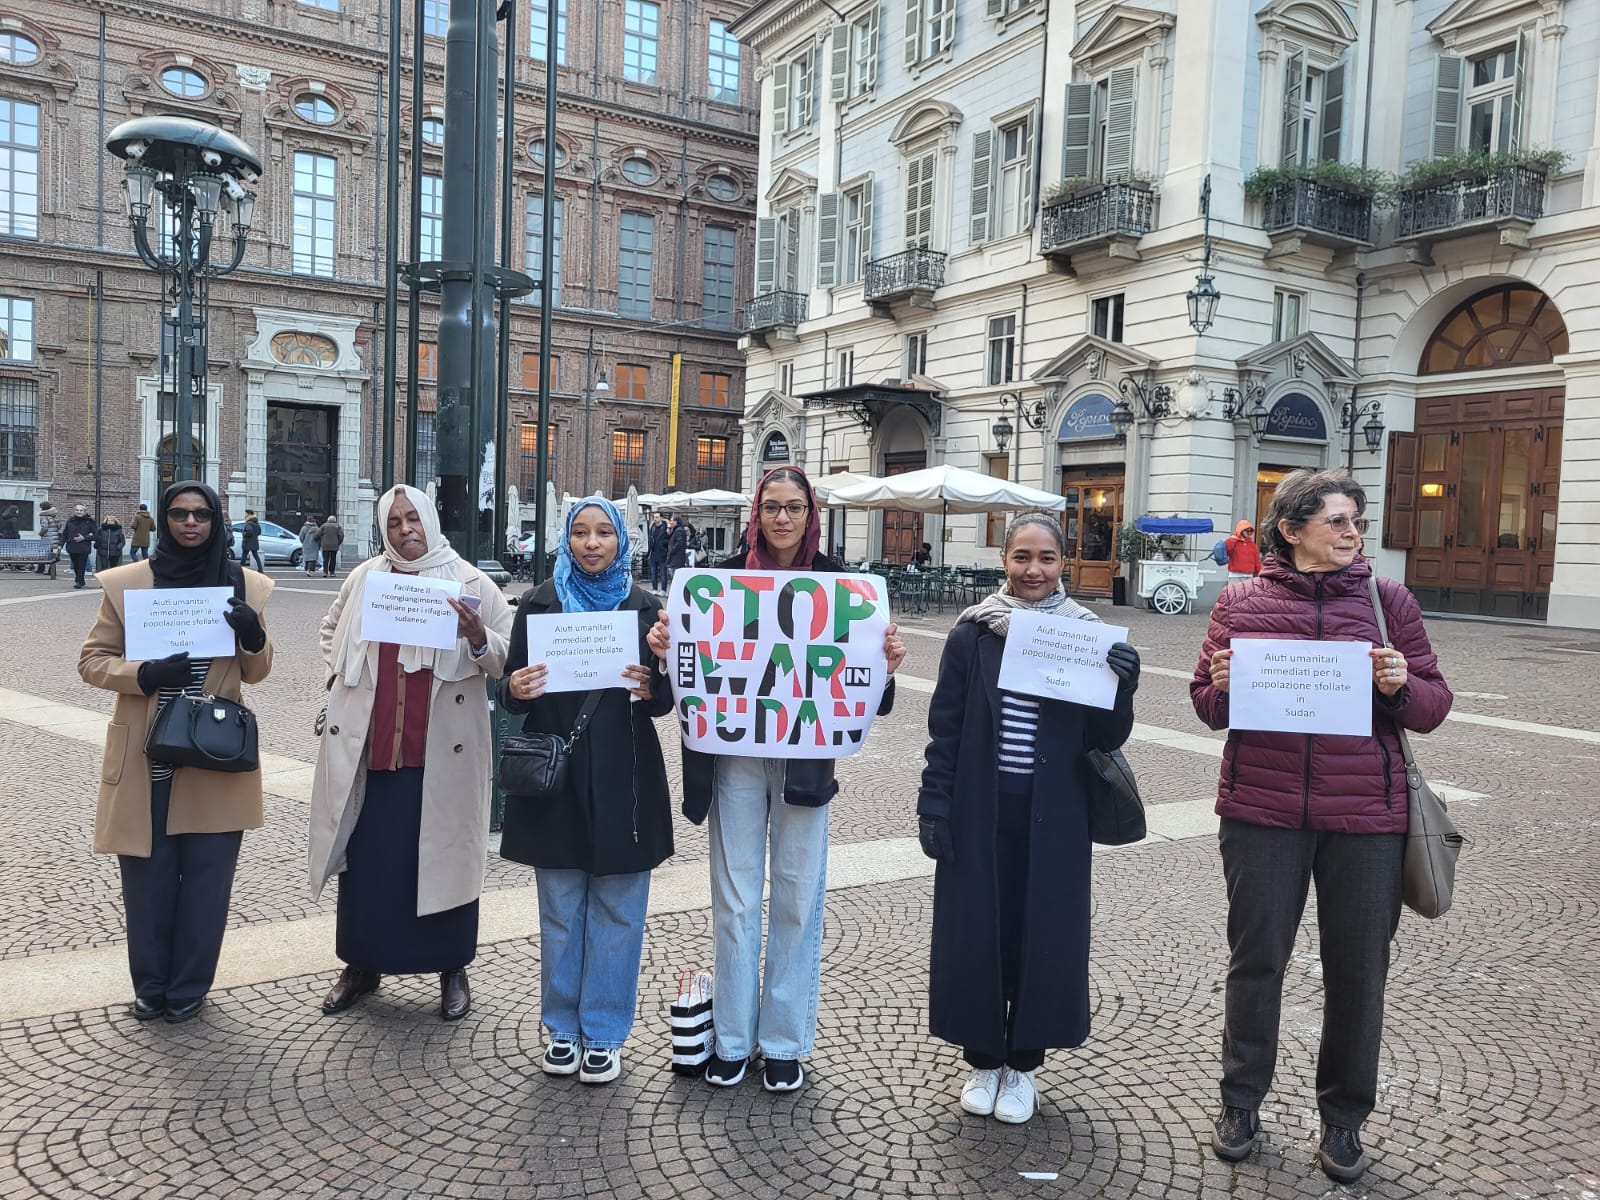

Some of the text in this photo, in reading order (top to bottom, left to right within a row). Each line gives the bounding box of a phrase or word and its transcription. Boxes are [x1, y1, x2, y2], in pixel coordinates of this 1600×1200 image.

[1270, 407, 1318, 432] Pepino
[394, 584, 424, 594] Facilitare
[382, 594, 443, 605] ricongiungimento
[371, 602, 406, 612] famigliare
[425, 608, 452, 617] rifugiati
[681, 574, 878, 643] STOP
[143, 620, 191, 628] popolazione
[395, 614, 427, 624] sudanese
[575, 623, 613, 631] umanitari
[1037, 625, 1098, 643] Aiuti umanitari
[552, 636, 592, 644] immediati
[1032, 636, 1098, 656] immediati per la
[545, 648, 594, 657] popolazione
[1264, 653, 1338, 663] Aiuti umanitari
[1022, 648, 1104, 669] popolazione sfollate
[679, 640, 869, 699] THE WAR IN
[1261, 667, 1341, 678] immediati per la
[1046, 676, 1070, 687] Sudan
[1252, 680, 1351, 692] popolazione sfollate
[1285, 708, 1315, 717] Sudan
[680, 696, 866, 746] SUDAN
